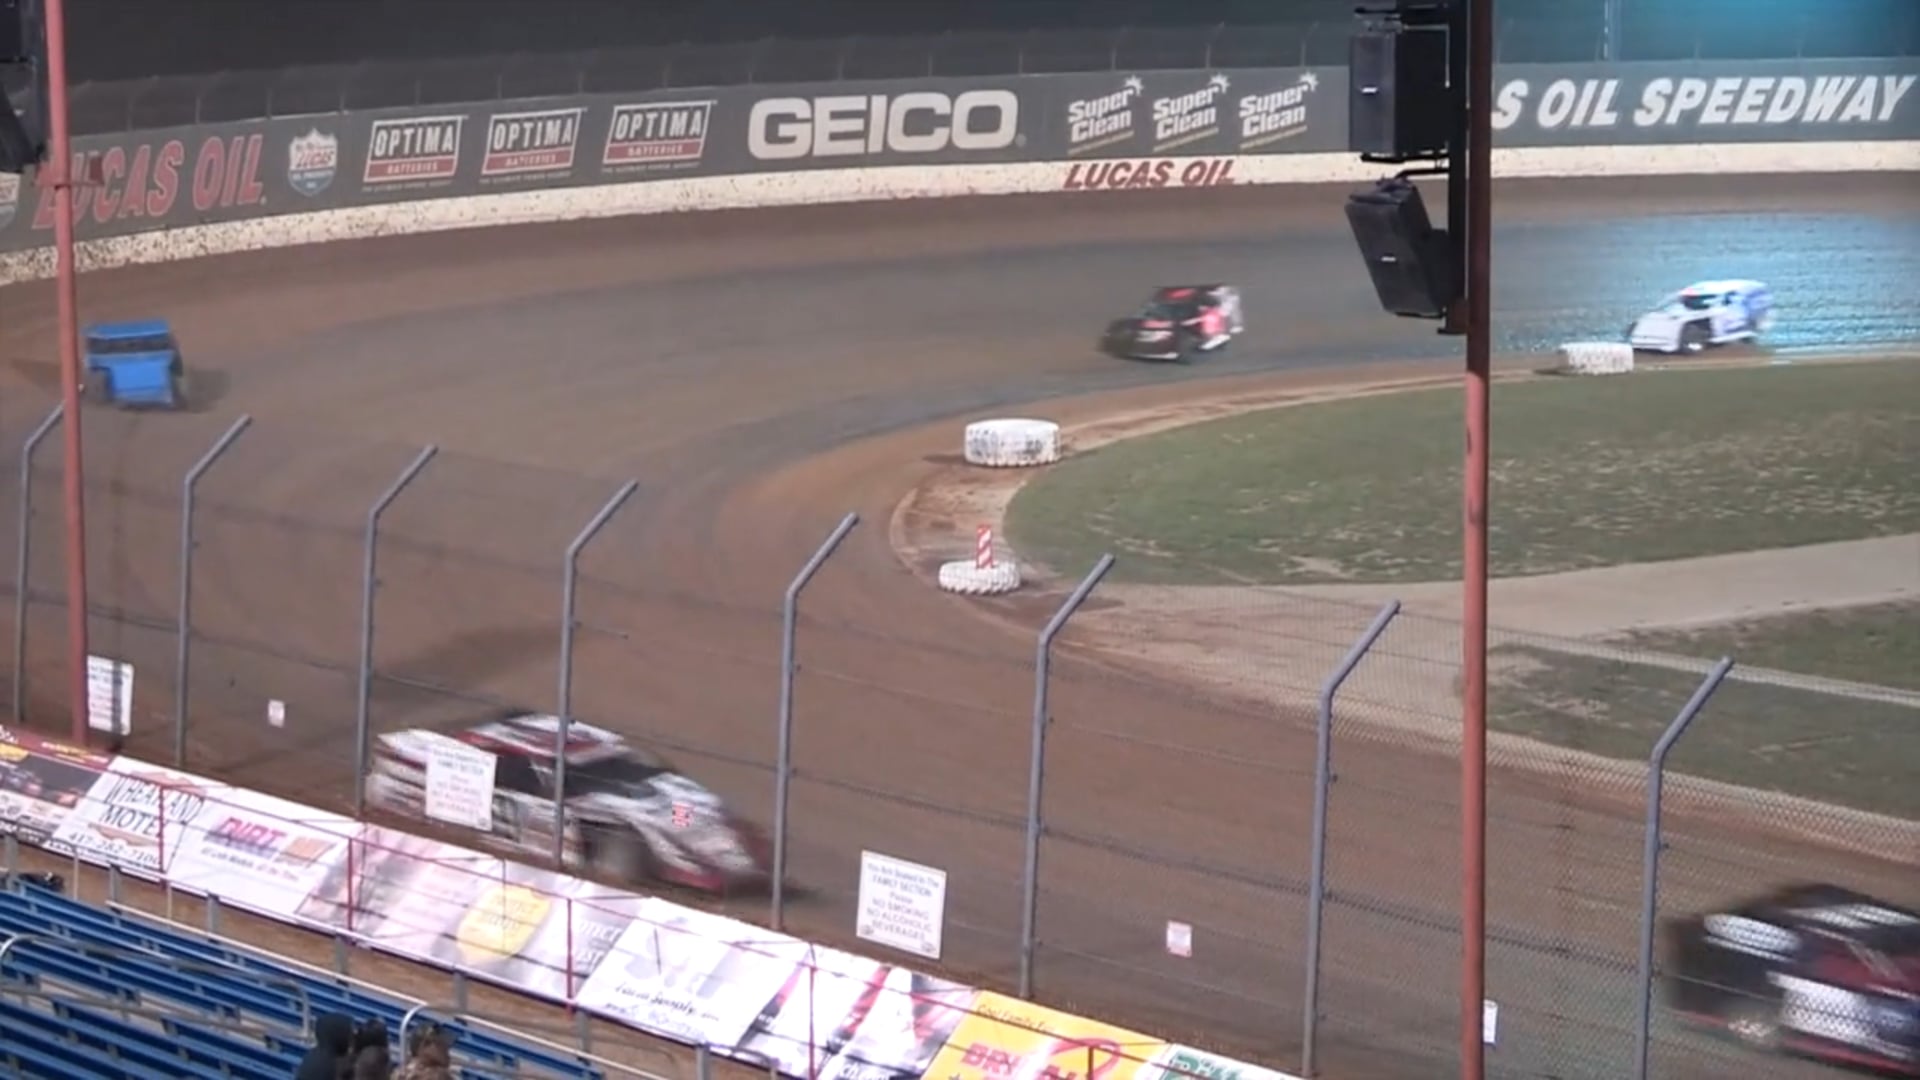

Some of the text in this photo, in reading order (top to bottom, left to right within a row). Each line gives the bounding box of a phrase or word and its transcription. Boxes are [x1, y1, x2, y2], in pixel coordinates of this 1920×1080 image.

[1067, 90, 1136, 124] Super
[1153, 87, 1220, 121] Super
[1239, 84, 1309, 118] Super
[1536, 79, 1620, 128] OIL
[1633, 75, 1917, 126] SPEEDWAY
[493, 116, 574, 150] OPTIMA
[611, 110, 704, 141] OPTIMA
[747, 90, 1019, 159] GEICO
[1071, 110, 1133, 142] Clean
[1157, 107, 1217, 140] Clean
[1242, 105, 1306, 137] Clean
[374, 125, 455, 157] OPTIMA
[192, 133, 266, 210] OIL
[1064, 160, 1236, 188] LUCAS OIL
